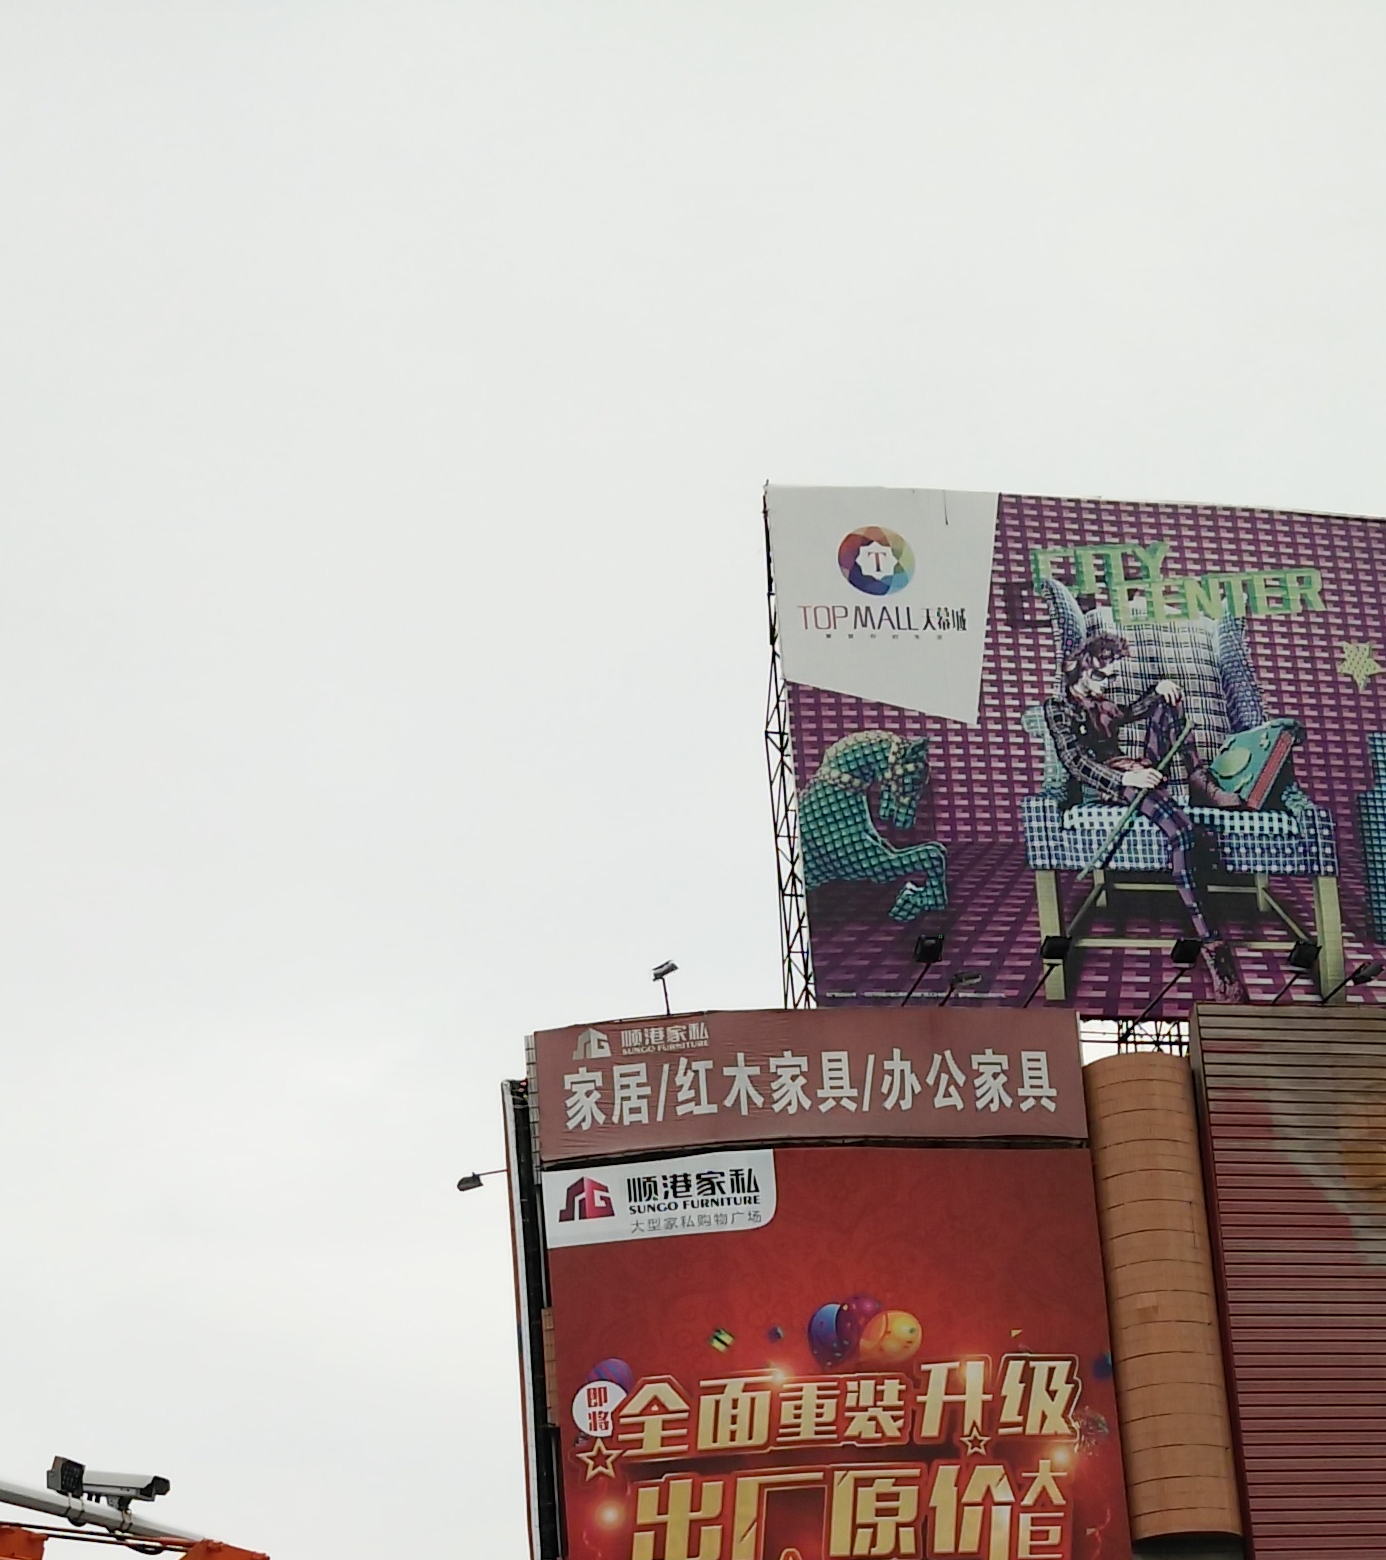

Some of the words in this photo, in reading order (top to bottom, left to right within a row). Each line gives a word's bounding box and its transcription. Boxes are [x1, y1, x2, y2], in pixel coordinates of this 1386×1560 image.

[1112, 568, 1327, 624] CENTER
[798, 605, 849, 630] TOP
[853, 605, 919, 631] MALL
[620, 1021, 710, 1048] 顺港家私
[562, 1049, 1058, 1133] 家居/红木家具/办公家具
[626, 1167, 761, 1204] 顺港家私
[628, 1200, 680, 1216] SUNGO
[682, 1194, 762, 1211] FURNITURE
[631, 1210, 763, 1234] 大型家私购物广场
[586, 1384, 610, 1432] 即将
[617, 1358, 1077, 1458] 全面重装升级
